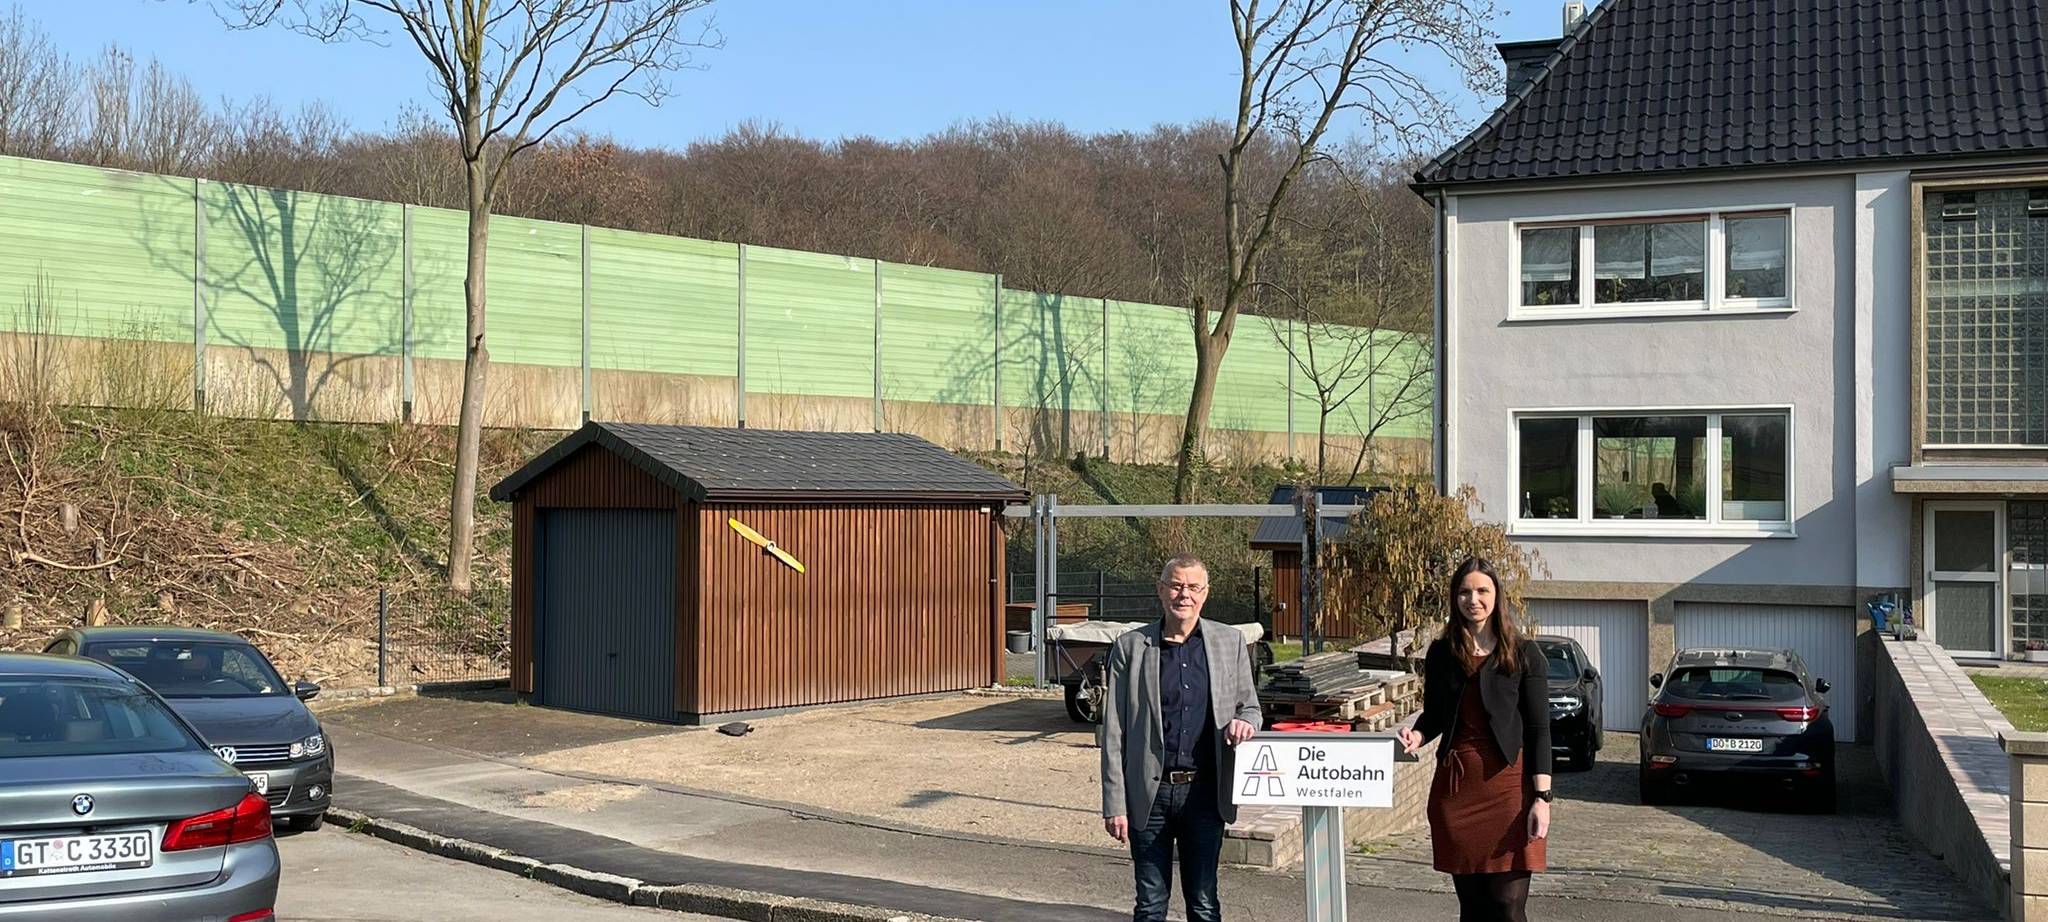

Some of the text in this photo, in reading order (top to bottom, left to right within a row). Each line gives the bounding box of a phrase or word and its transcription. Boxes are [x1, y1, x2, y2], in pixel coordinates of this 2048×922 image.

[1712, 738, 1762, 750] DO B 2120
[1298, 746, 1326, 761] Die
[1297, 765, 1385, 781] Autobahn
[1296, 787, 1363, 798] Westfalen
[17, 842, 50, 865] GT
[67, 840, 82, 861] C
[88, 836, 147, 860] 3330
